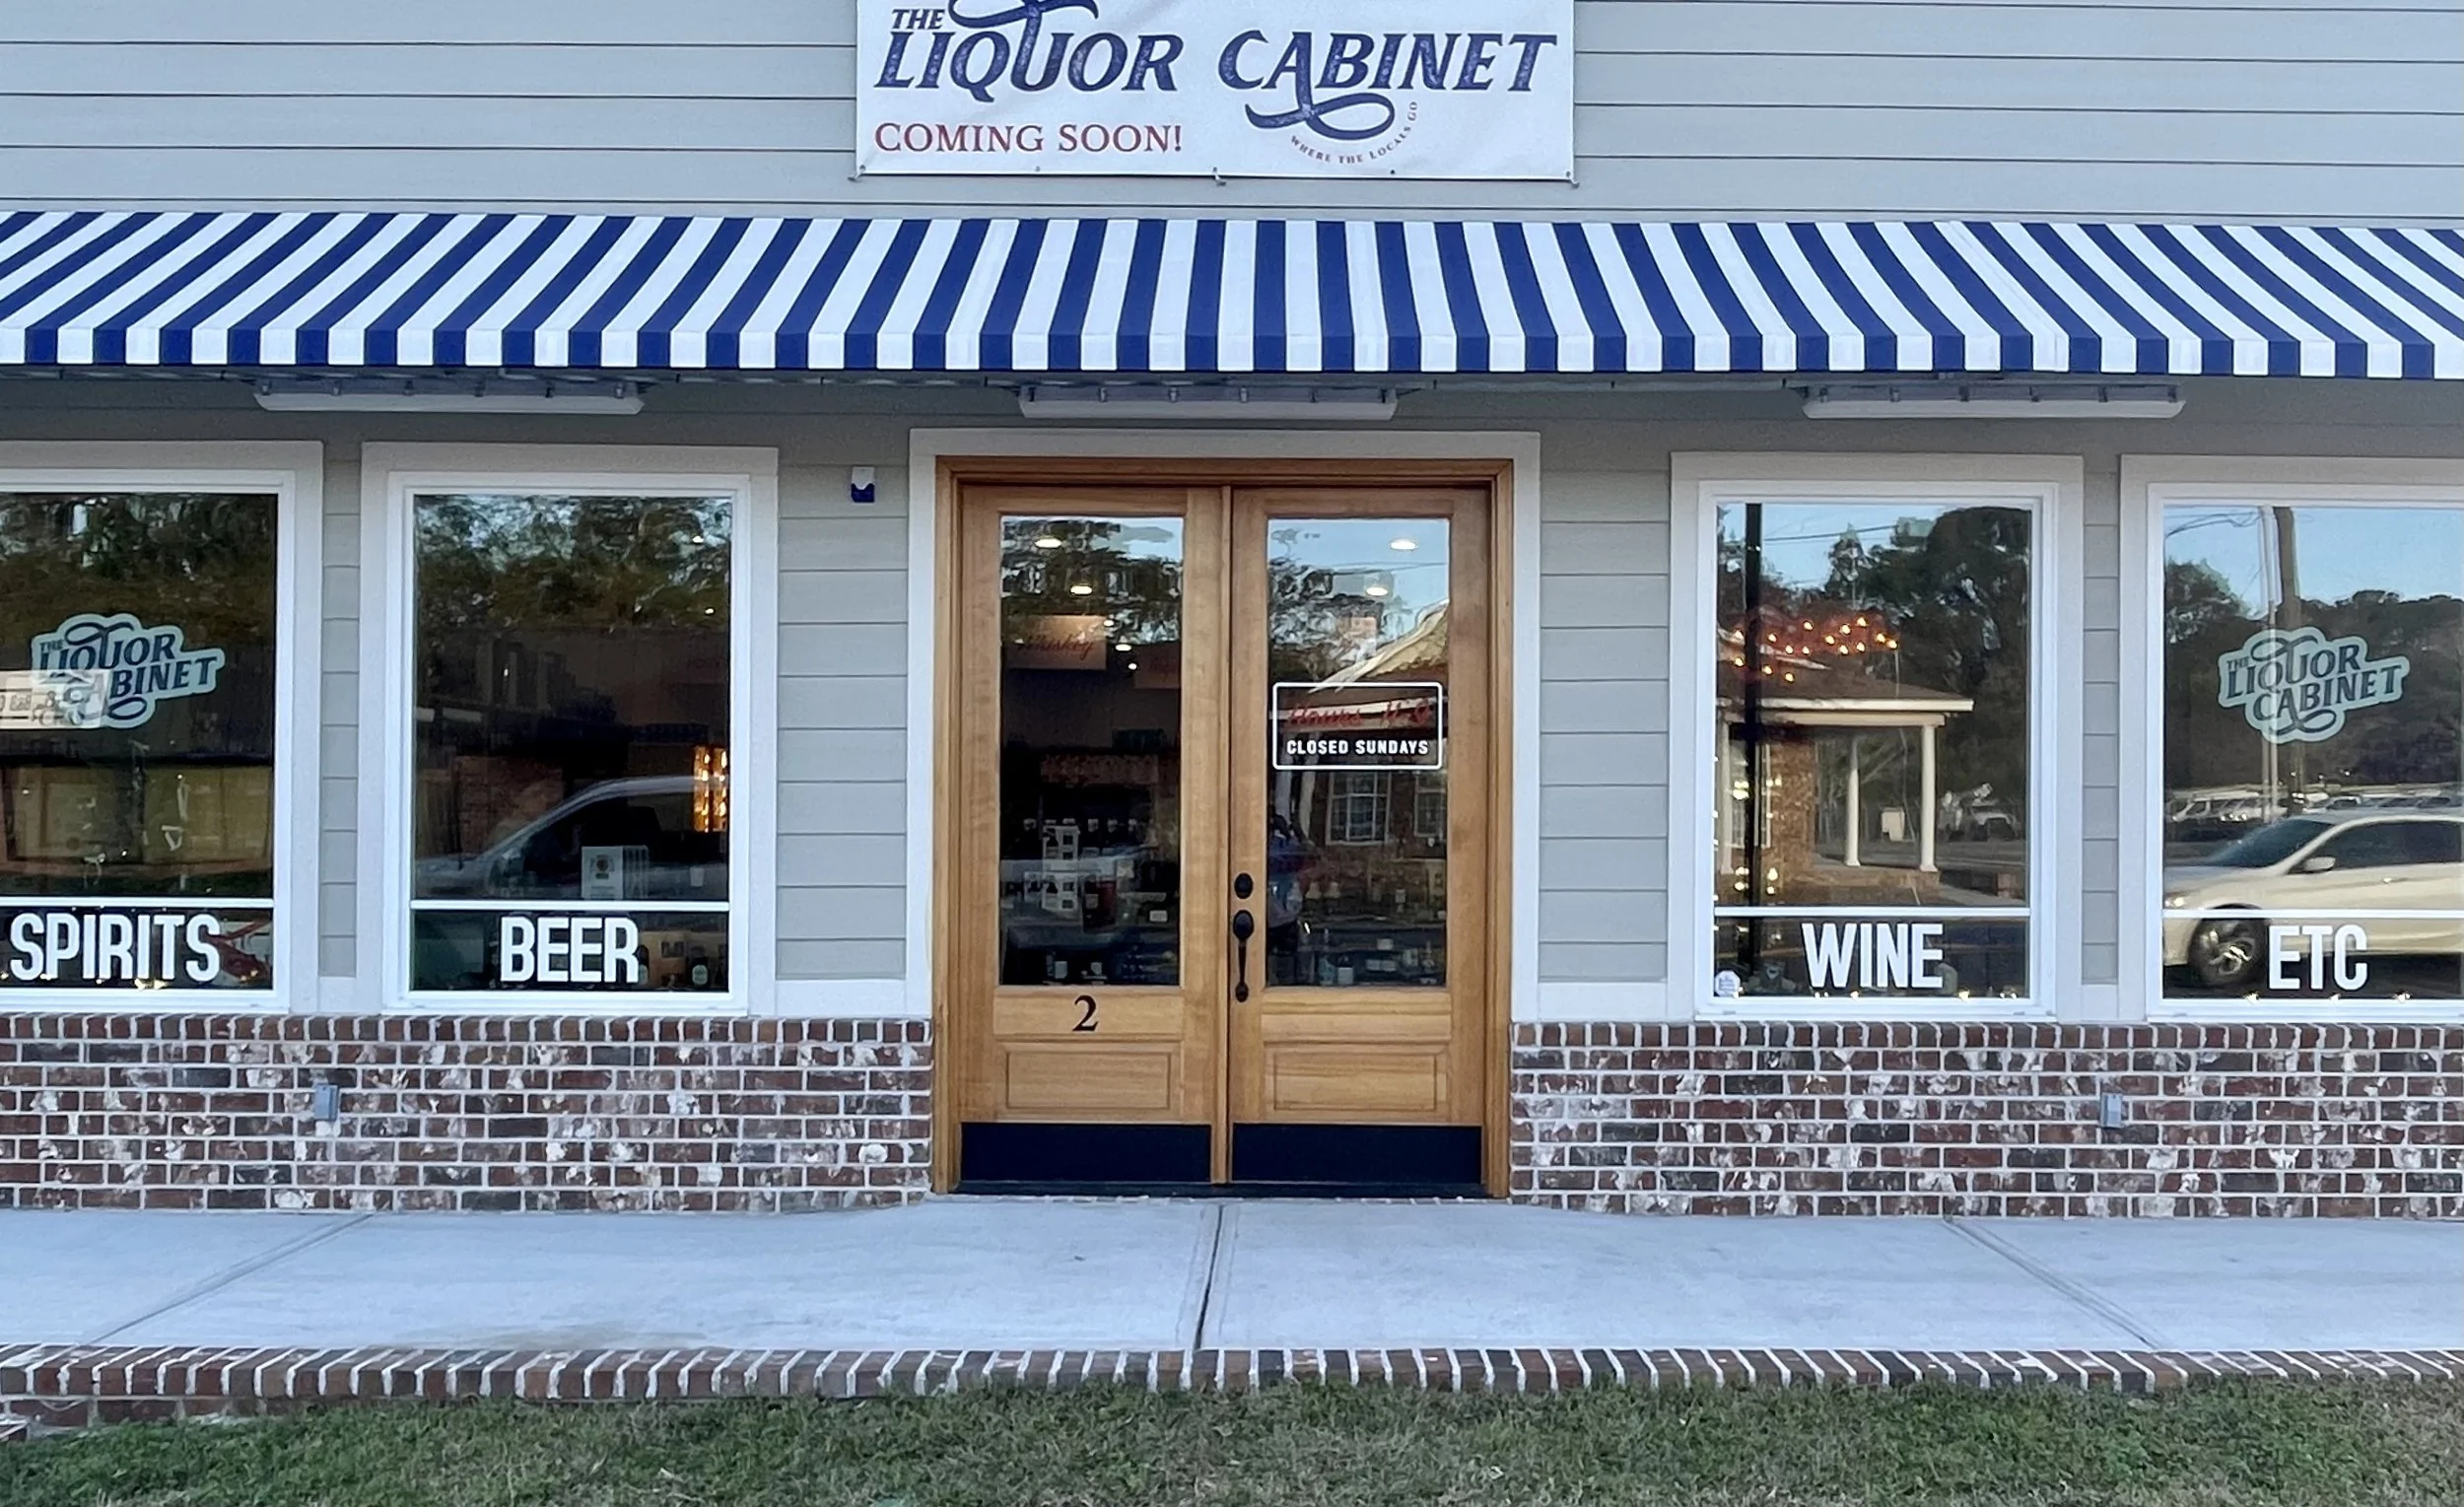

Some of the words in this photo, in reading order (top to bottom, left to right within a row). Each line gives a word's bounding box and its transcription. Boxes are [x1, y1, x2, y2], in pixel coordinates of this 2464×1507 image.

[892, 9, 945, 30] THE
[873, 0, 1184, 103] LIQUOR
[1218, 30, 1557, 140] CABINET
[875, 123, 1044, 152] COMING
[1059, 124, 1182, 152] SOON!
[1291, 135, 1332, 163] WHERE
[1338, 154, 1364, 164] THE
[1369, 126, 1411, 160] LOCALS
[1406, 102, 1418, 121] GO
[40, 639, 64, 651] THE
[2226, 655, 2249, 671] THE
[2226, 636, 2361, 699] LIQUOR
[2253, 664, 2402, 736] CABINET
[1286, 740, 1349, 755] CLOSED
[1355, 739, 1429, 755] SUNDAYS
[10, 913, 221, 982] SPIRITS
[501, 917, 640, 984] BEER
[1802, 923, 1944, 989] WINE
[2269, 925, 2367, 991] ETC
[1072, 994, 1099, 1032] 2
